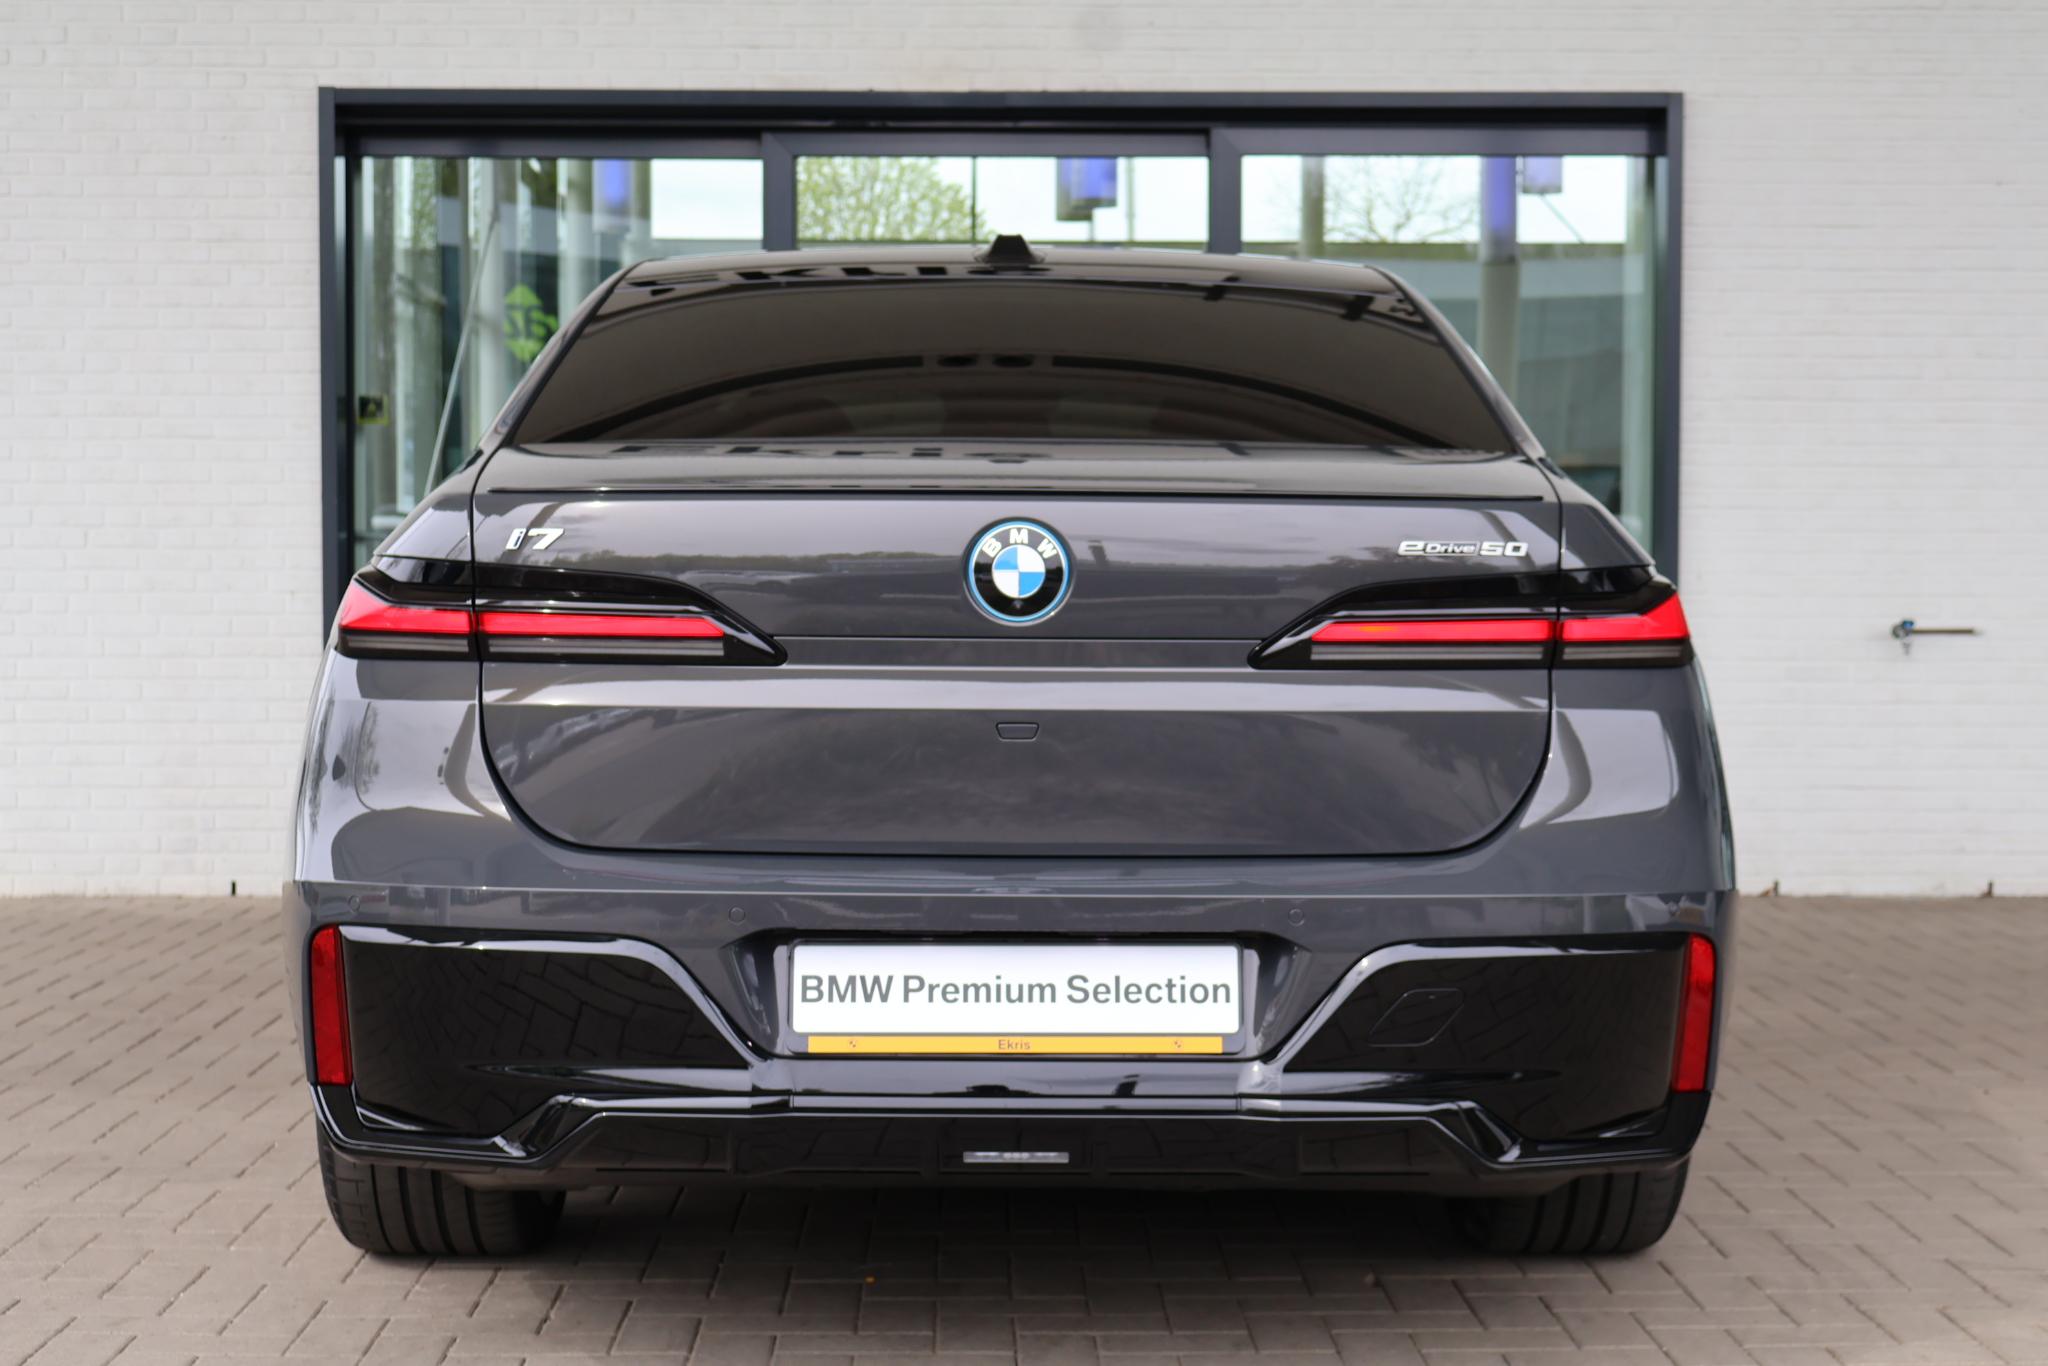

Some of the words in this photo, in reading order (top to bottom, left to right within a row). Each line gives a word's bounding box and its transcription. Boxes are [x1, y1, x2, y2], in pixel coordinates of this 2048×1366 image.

[505, 527, 565, 551] i7
[981, 527, 1058, 559] BMW
[800, 974, 894, 1004] BMW
[902, 974, 1057, 1004] Premium
[1066, 974, 1232, 1005] Selection
[998, 1039, 1031, 1050] Ekris
